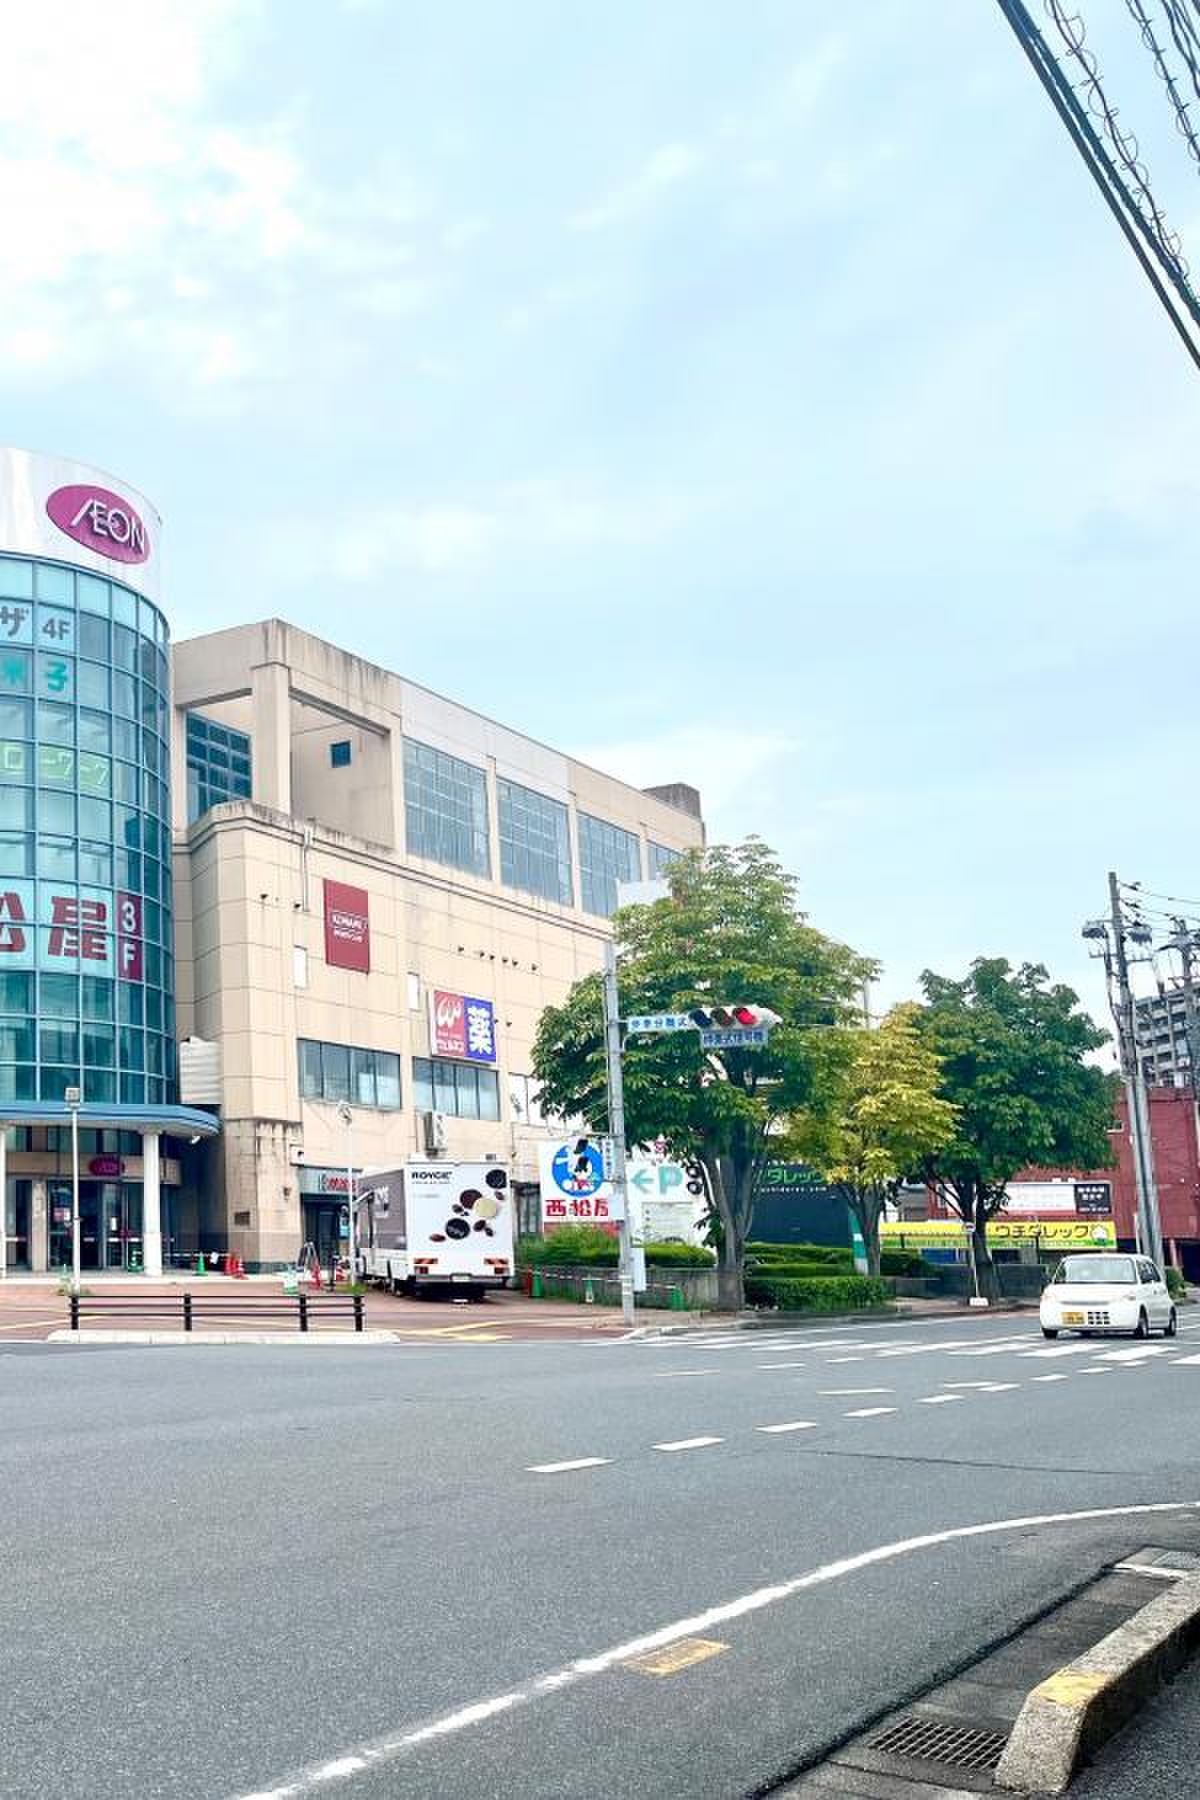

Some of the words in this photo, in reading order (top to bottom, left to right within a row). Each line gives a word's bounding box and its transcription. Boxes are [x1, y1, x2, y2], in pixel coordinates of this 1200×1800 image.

[43, 618, 71, 640] 4F
[466, 1004, 493, 1055] 薬
[995, 1224, 1089, 1239] ウチダレック
